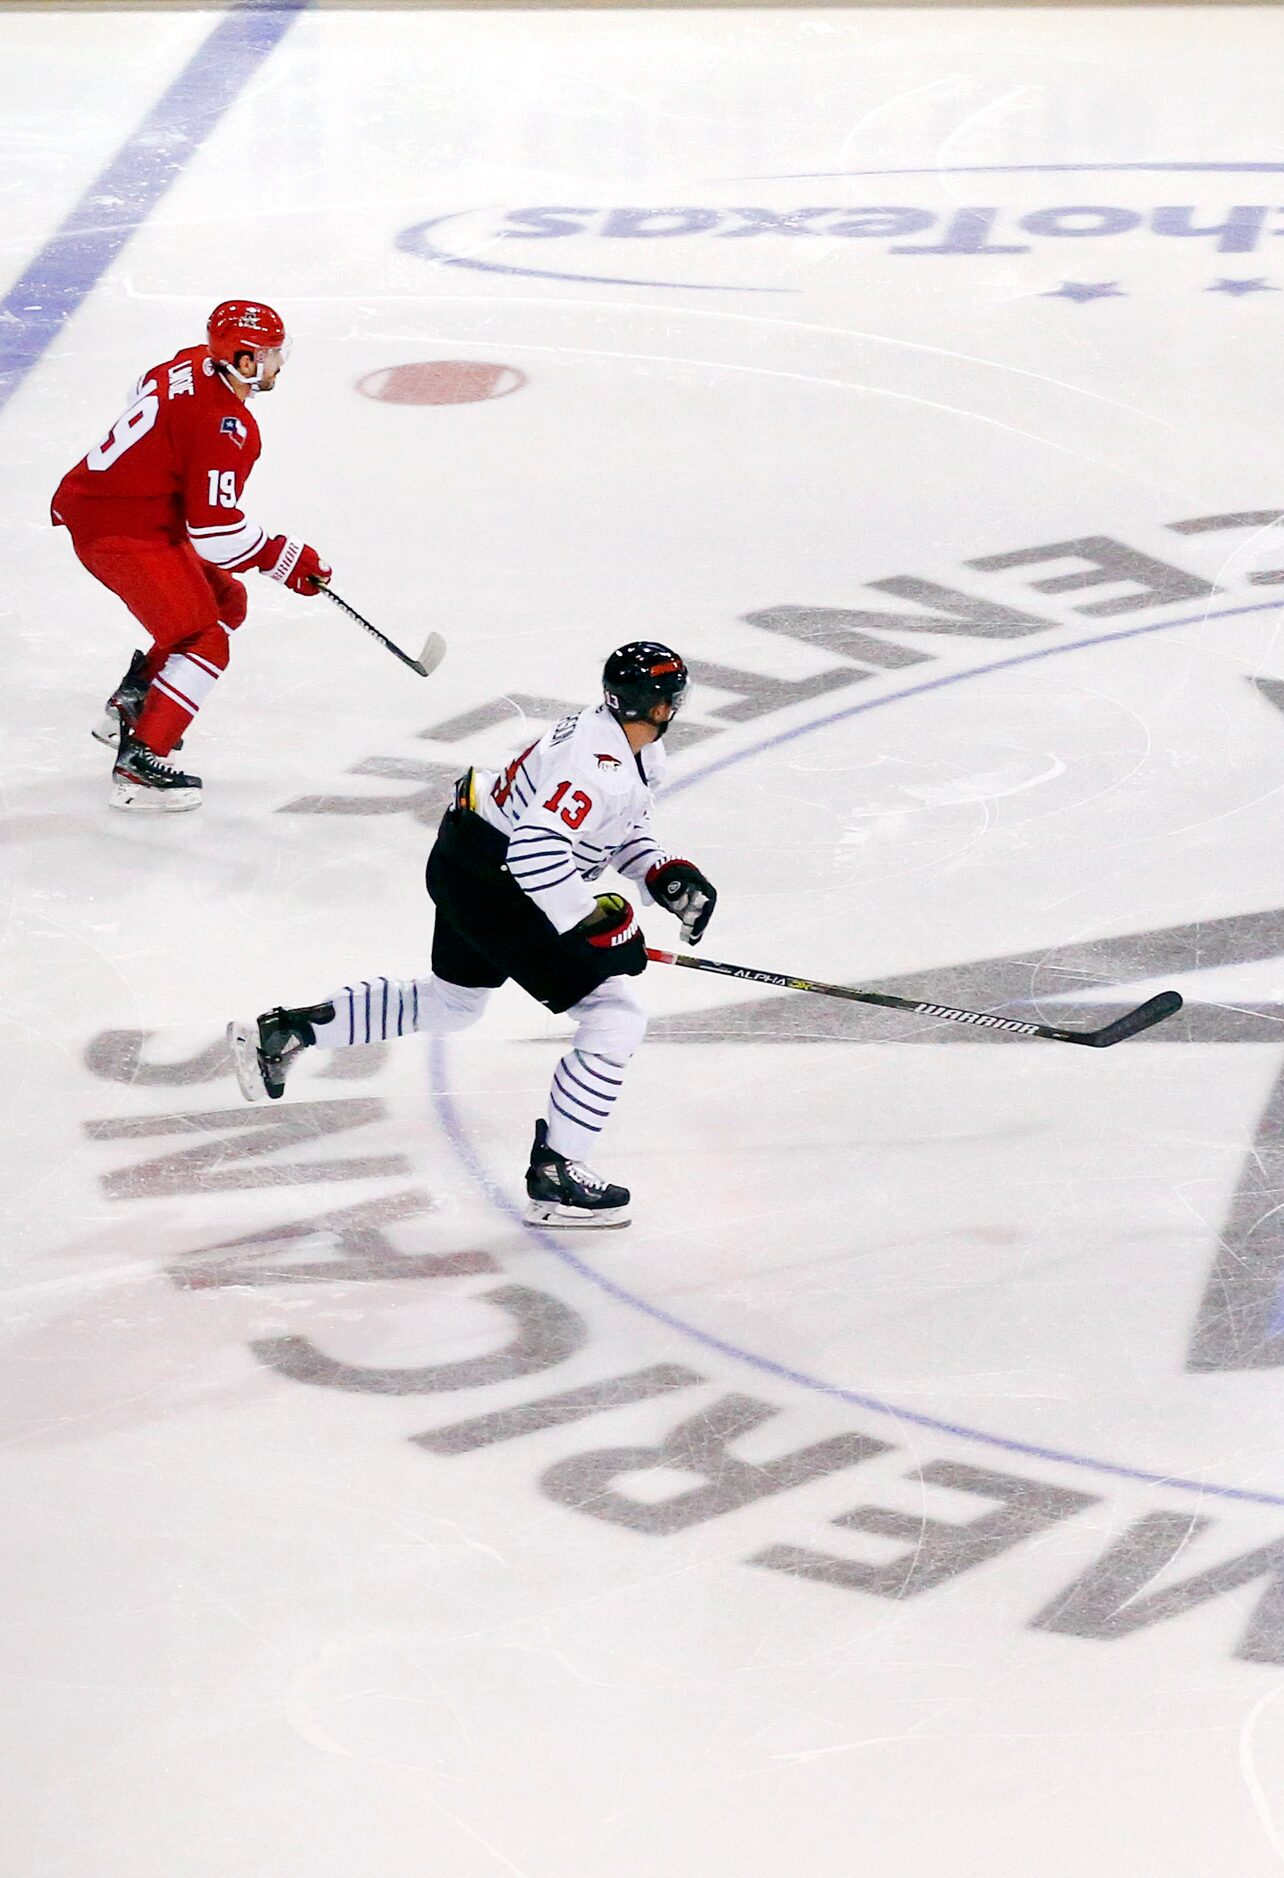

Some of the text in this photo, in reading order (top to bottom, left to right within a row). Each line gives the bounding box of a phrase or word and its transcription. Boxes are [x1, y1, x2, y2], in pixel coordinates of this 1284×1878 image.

[207, 470, 237, 508] 19
[543, 780, 593, 830] 13
[733, 968, 788, 988] ALPHA
[913, 1003, 1040, 1036] WARRIOR
